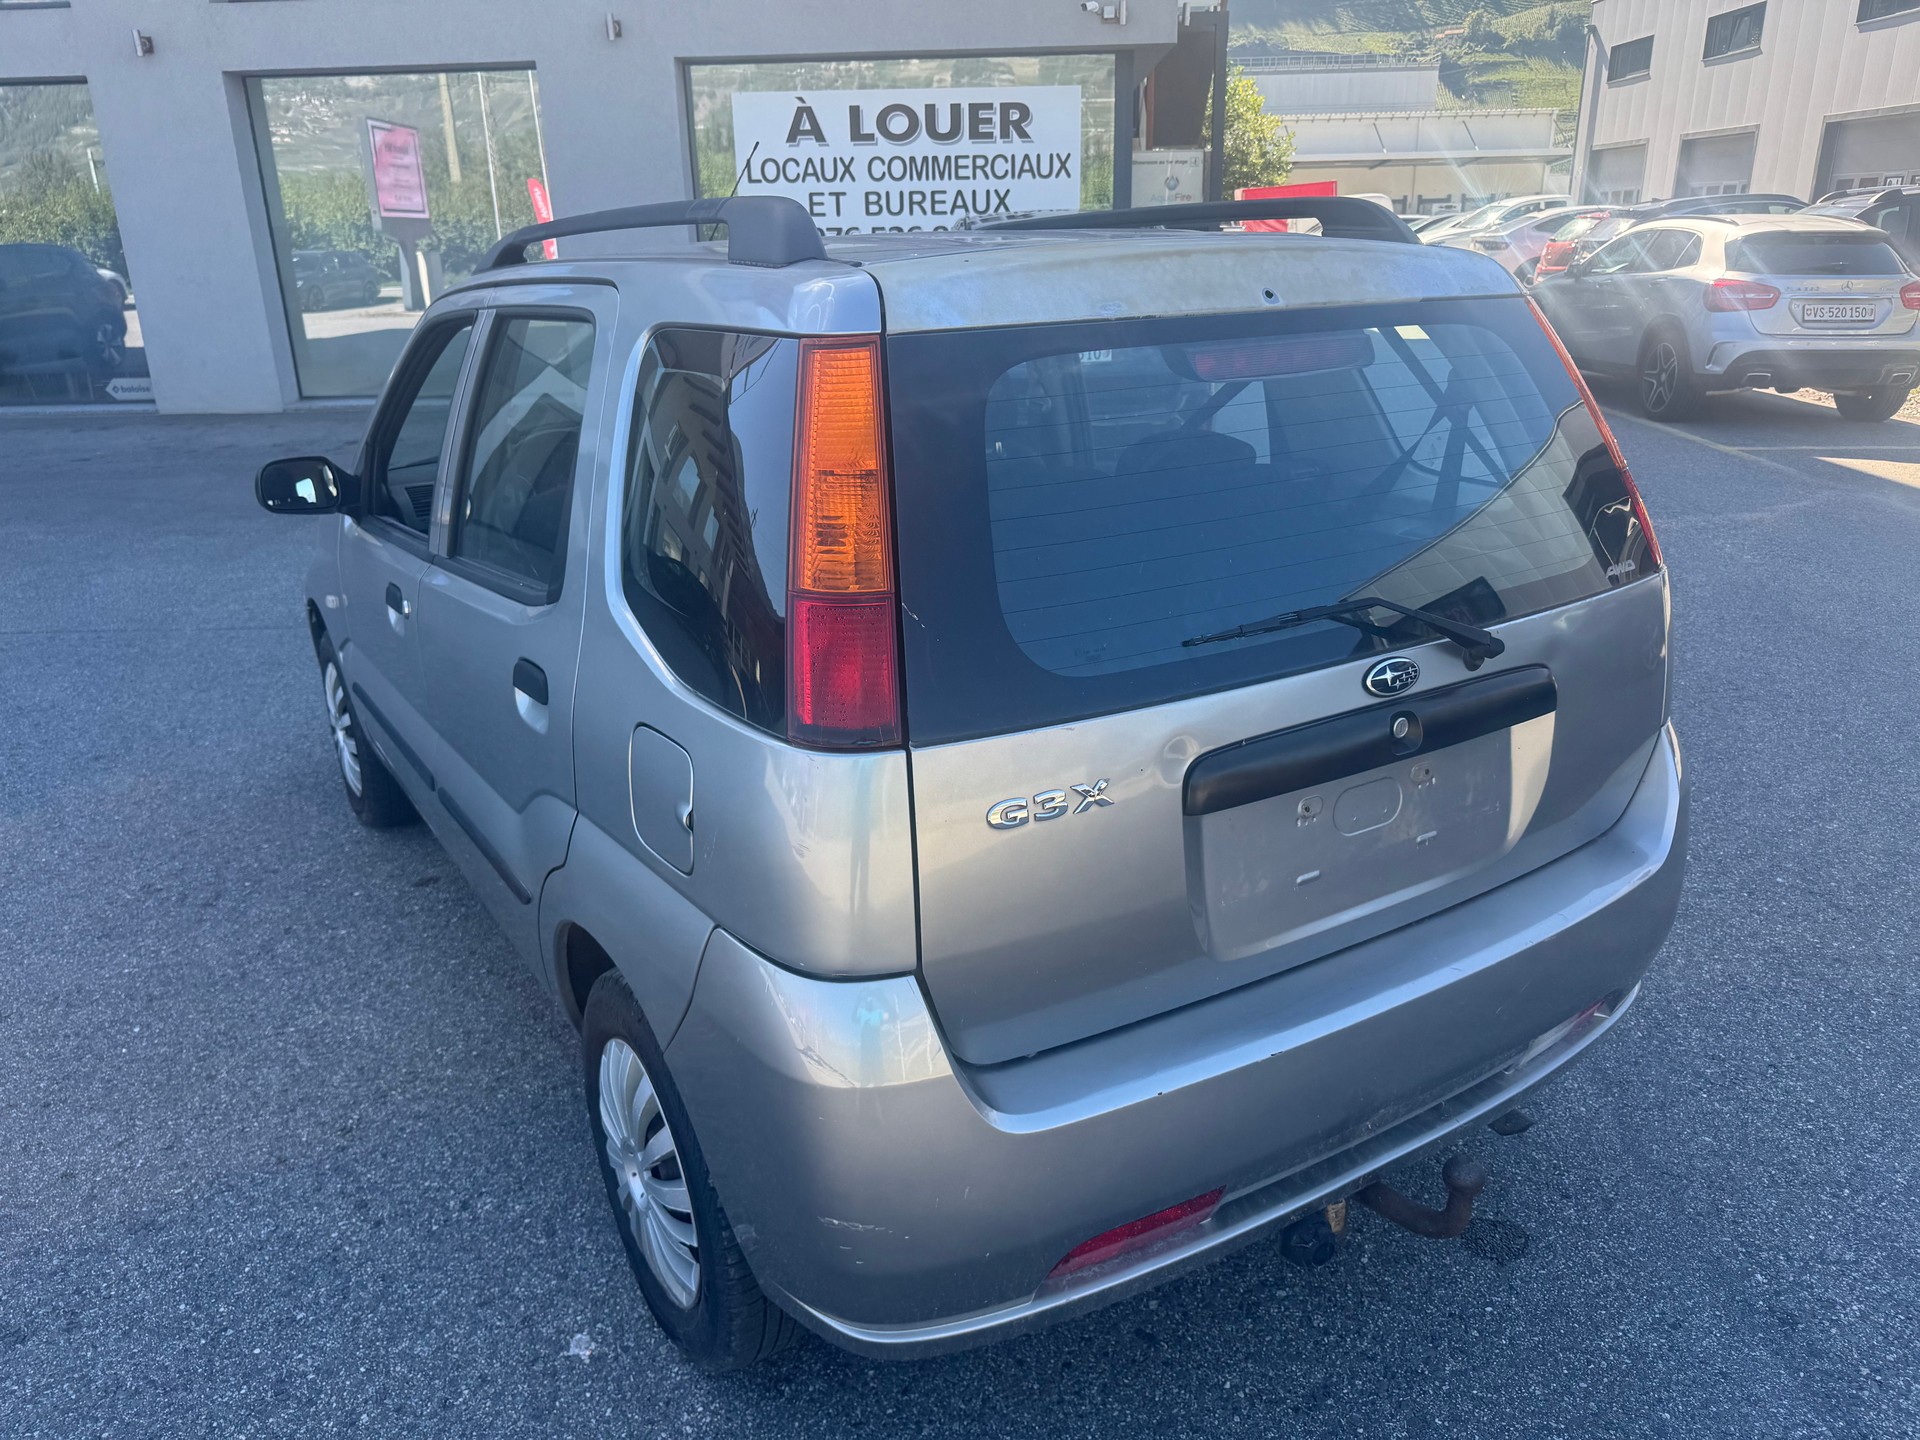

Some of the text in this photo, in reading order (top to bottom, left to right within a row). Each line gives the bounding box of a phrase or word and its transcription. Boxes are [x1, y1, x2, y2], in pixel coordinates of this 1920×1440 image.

[786, 97, 1034, 146] À LOUER
[746, 152, 1072, 184] LOCAUX COMMERCIAUX
[808, 188, 1011, 217] ET BUREAUX
[1606, 560, 1636, 578] AWD
[986, 778, 1115, 830] G3X
